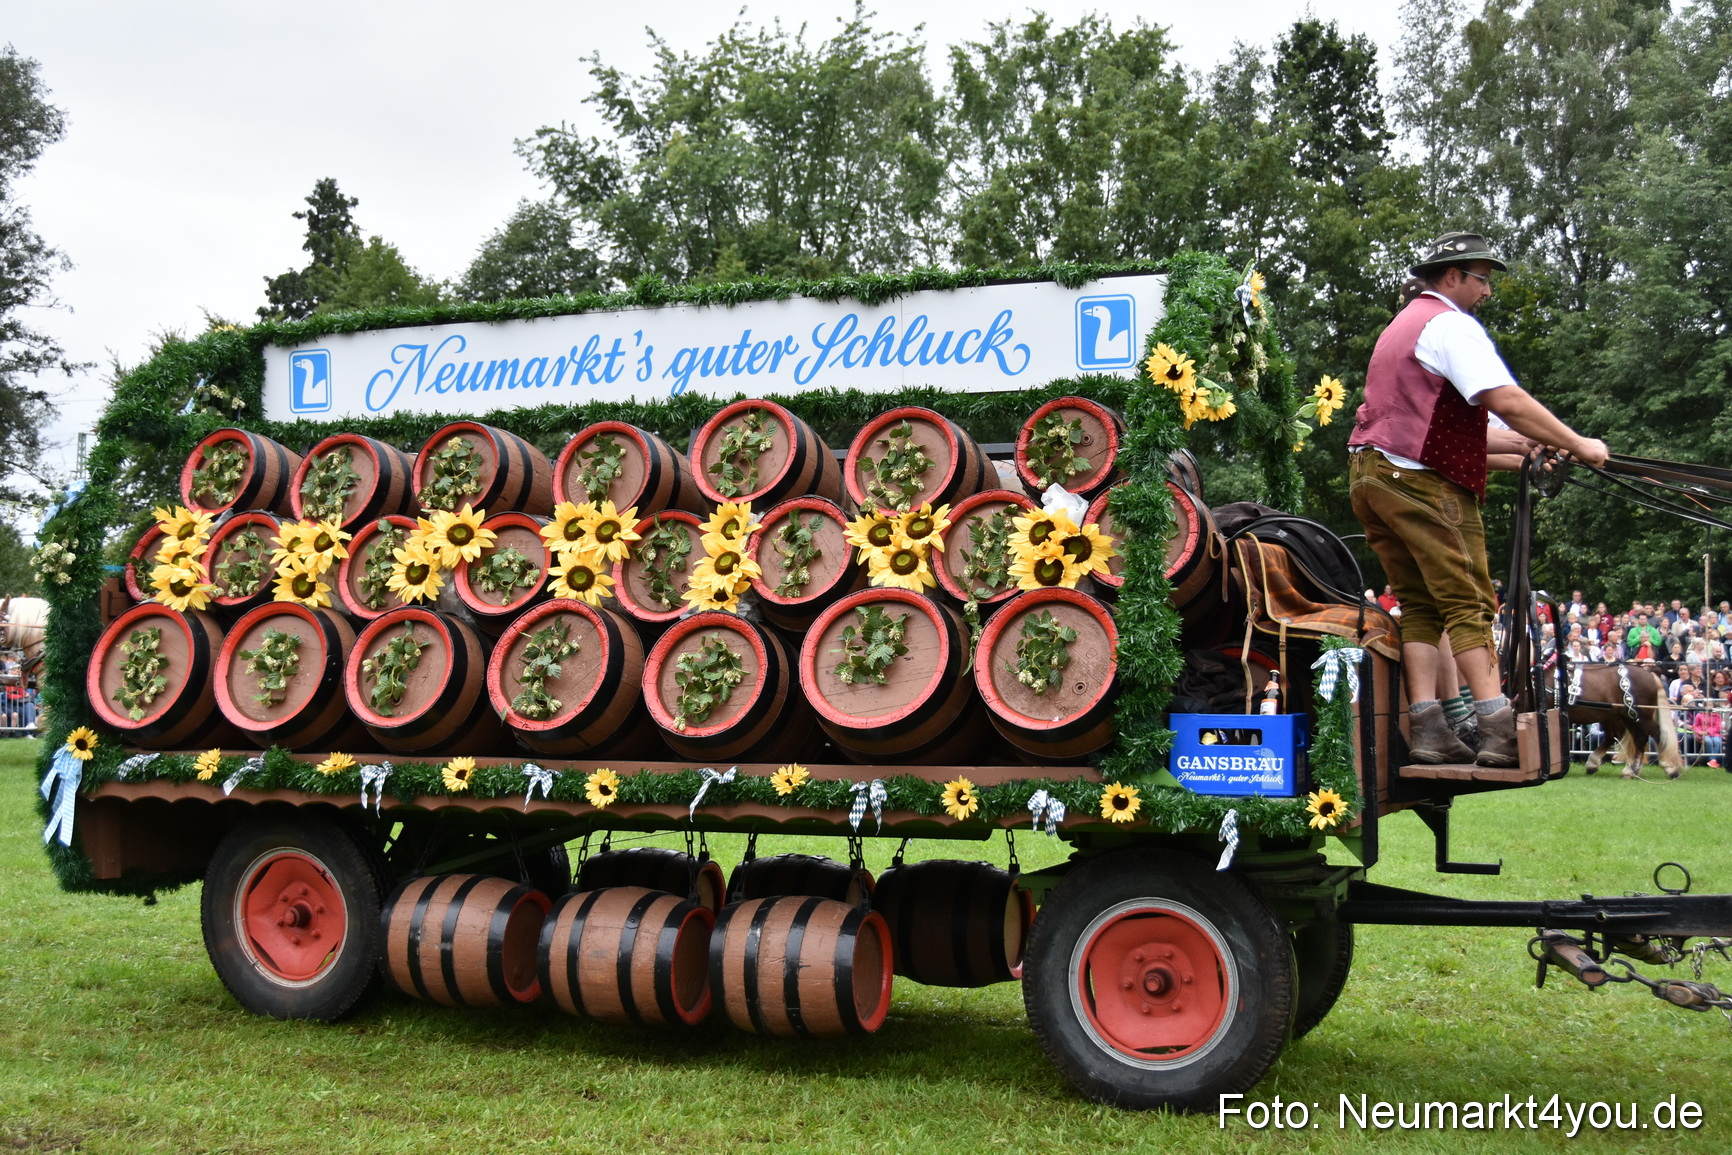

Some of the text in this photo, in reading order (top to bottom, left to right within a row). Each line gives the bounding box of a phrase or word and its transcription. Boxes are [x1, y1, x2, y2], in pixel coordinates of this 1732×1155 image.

[365, 310, 1031, 412] Neumarkt's guter Schluck
[1177, 755, 1284, 772] GANSBRÄU
[1227, 773, 1250, 784] guter
[1248, 773, 1284, 785] Schluck
